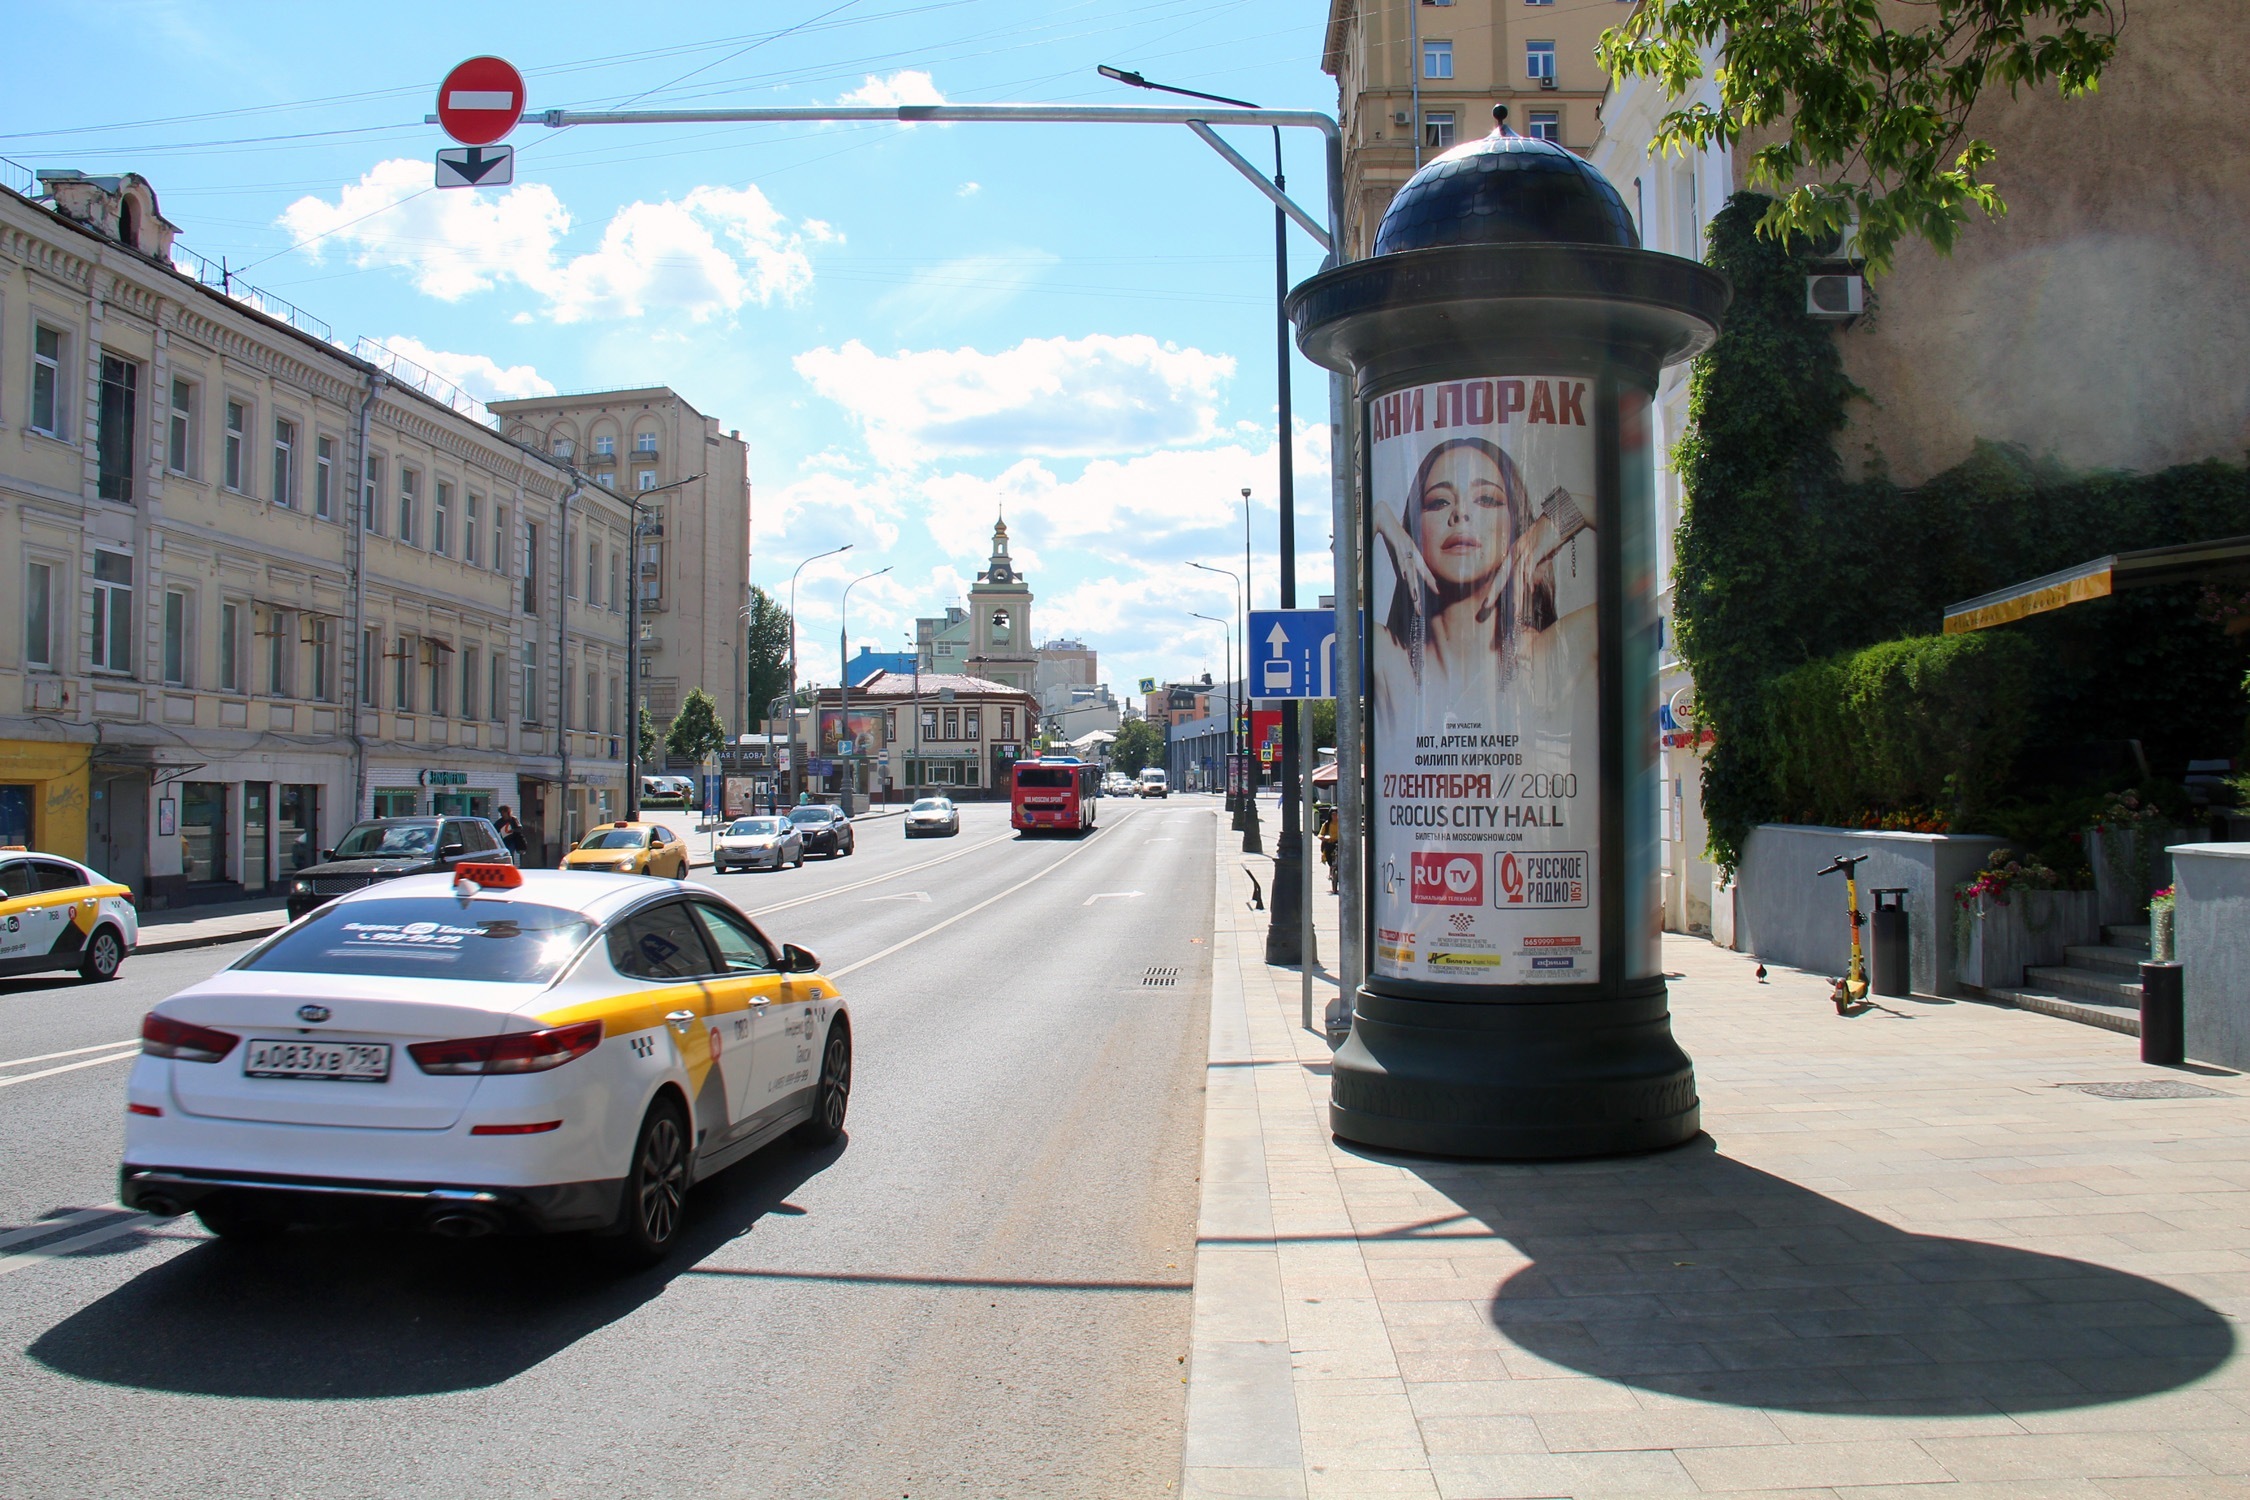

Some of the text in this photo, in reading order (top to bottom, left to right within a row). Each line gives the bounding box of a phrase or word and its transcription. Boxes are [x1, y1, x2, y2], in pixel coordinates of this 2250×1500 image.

[1373, 380, 1587, 444] АНИ ЛОРАК
[1416, 735, 1519, 749] МОТ, АРТЕМ КАЧЕР
[1414, 753, 1523, 766] ФИЛИПП КИРКОРОВ
[1384, 774, 1397, 798] 27
[1399, 773, 1492, 799] СЕНТЯБРЯ
[1521, 773, 1577, 799] 20:00
[1389, 804, 1564, 827] CROCUS CITY HALL
[1415, 832, 1523, 841] БИЛЕТЫ НА MOSCOWSHOW.COM
[1381, 861, 1406, 894] 12+
[1414, 865, 1471, 886] RU TV
[1527, 857, 1581, 879] РУССКОЕ
[1527, 881, 1569, 903] РАДИО
[48, 911, 59, 920] 768
[370, 933, 464, 943] 999-99-99
[1445, 957, 1472, 965] Билеты
